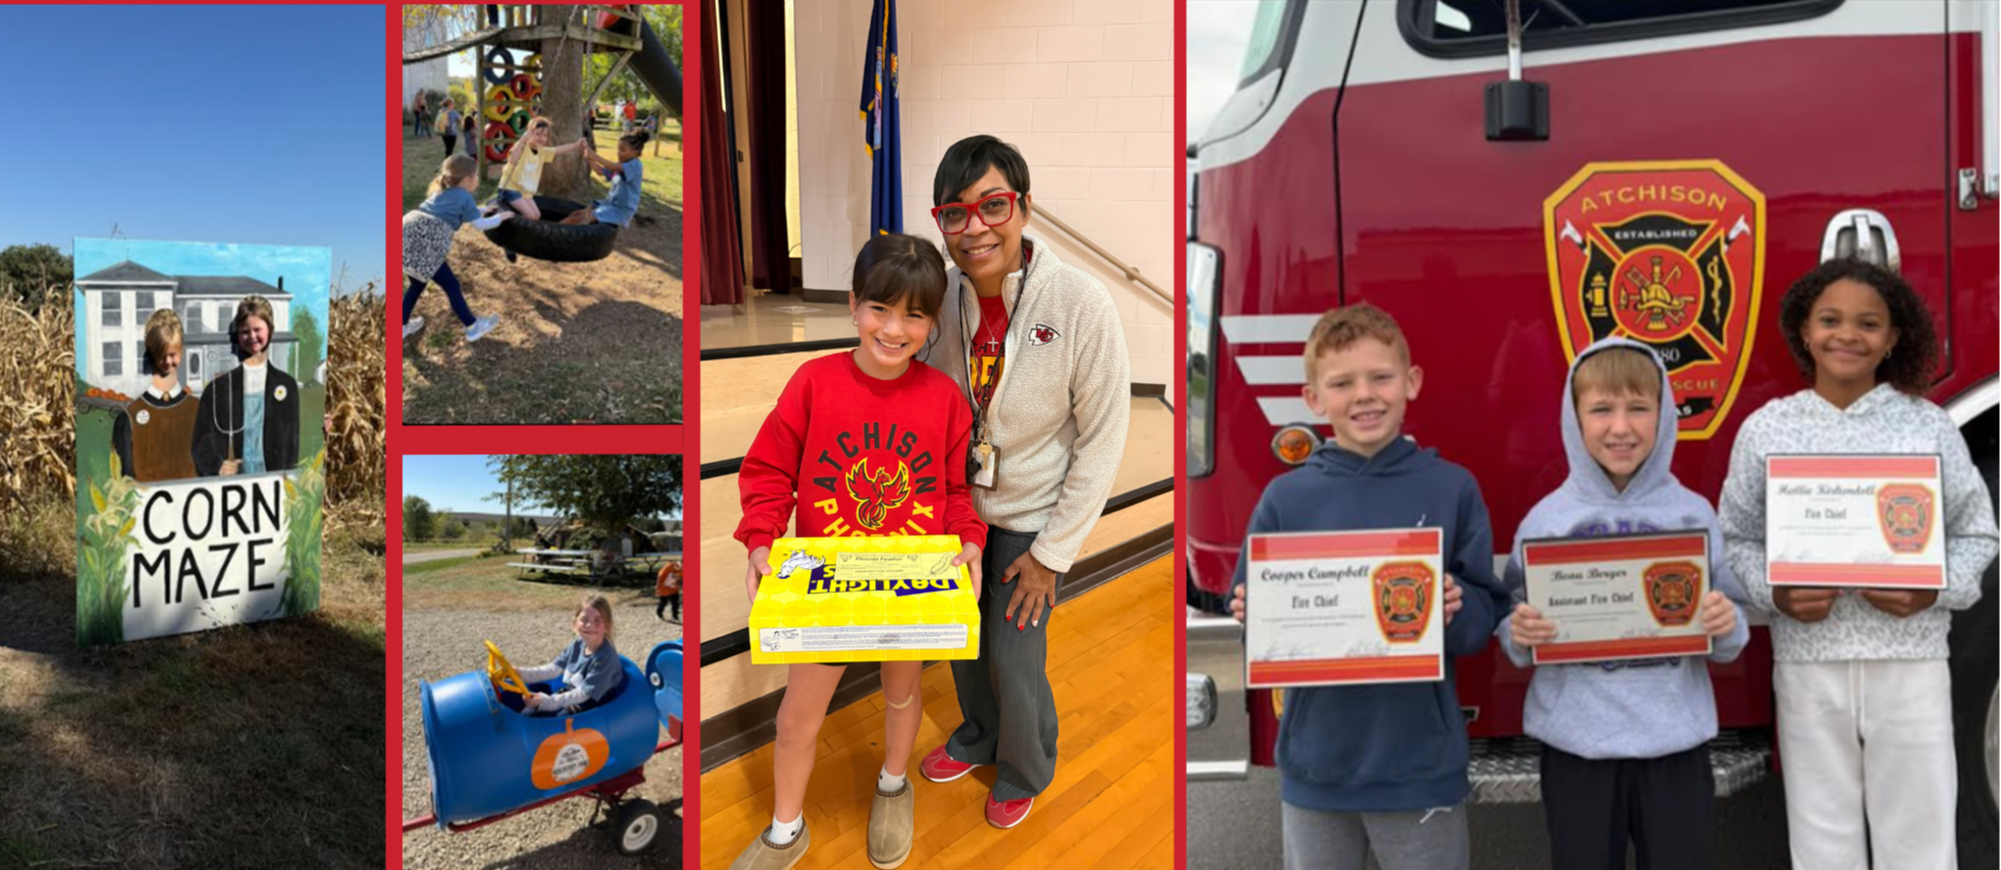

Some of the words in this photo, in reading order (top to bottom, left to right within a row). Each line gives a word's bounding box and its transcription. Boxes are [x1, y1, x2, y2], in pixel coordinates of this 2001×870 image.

[1581, 185, 1727, 214] ATCHISON
[1614, 229, 1697, 240] ESTABLISHED
[1661, 348, 1680, 362] 80
[1672, 380, 1719, 390] SCUE
[813, 422, 937, 495] ATCHISON
[143, 480, 280, 545] CORN
[814, 498, 934, 537] PHIX
[1825, 508, 1847, 519] Chief
[133, 538, 275, 608] MAZE
[1261, 568, 1304, 583] Cooper
[1308, 565, 1369, 580] Campbell
[1551, 569, 1583, 581] Beau
[1292, 596, 1309, 609] Fire
[1314, 595, 1339, 608] Chief
[1548, 596, 1587, 607] Assistant
[1591, 594, 1608, 605] Fire
[1611, 592, 1634, 603] Chief
